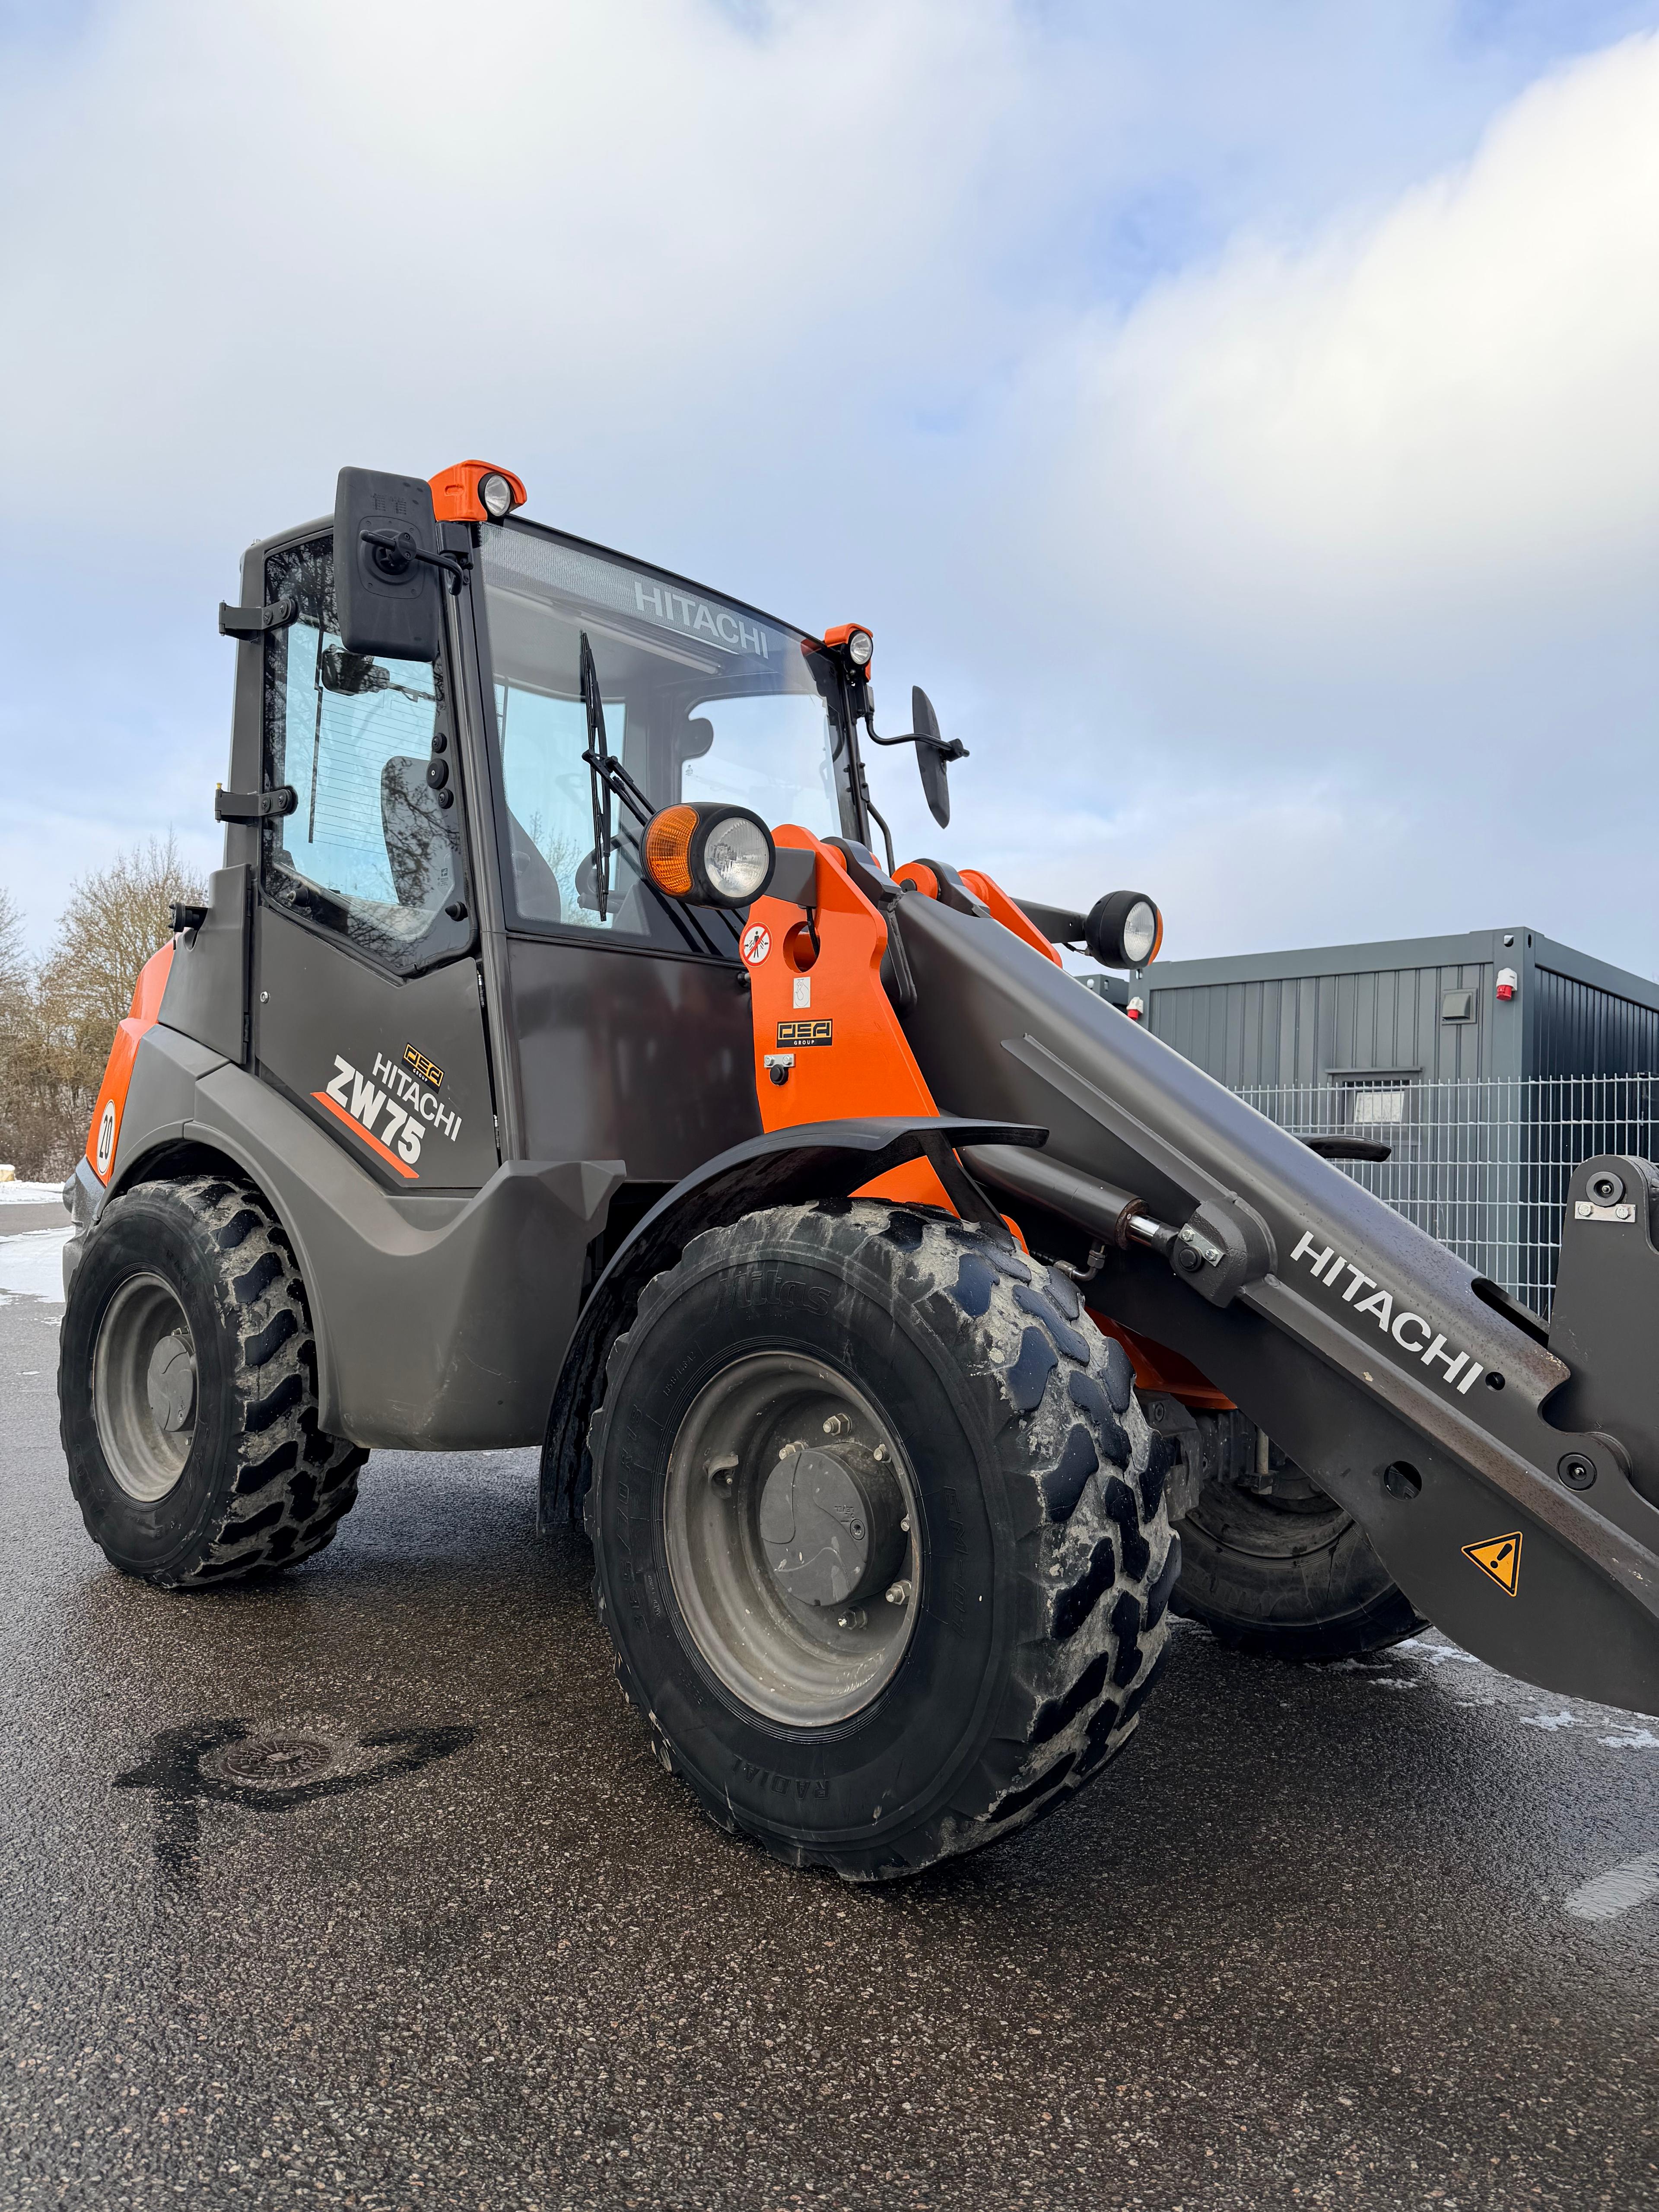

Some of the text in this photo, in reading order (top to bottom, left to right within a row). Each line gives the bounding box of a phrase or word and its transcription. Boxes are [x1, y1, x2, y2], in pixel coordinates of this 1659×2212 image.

[634, 581, 769, 660] HITACHI
[372, 1052, 462, 1142] HITACHI
[413, 1068, 428, 1082] GROUP
[99, 1114, 113, 1160] 20
[326, 1054, 426, 1164] ZW75
[711, 1269, 832, 1320] Mitas
[1290, 1230, 1484, 1395] HITACHI
[730, 1753, 831, 1800] RADIAL
